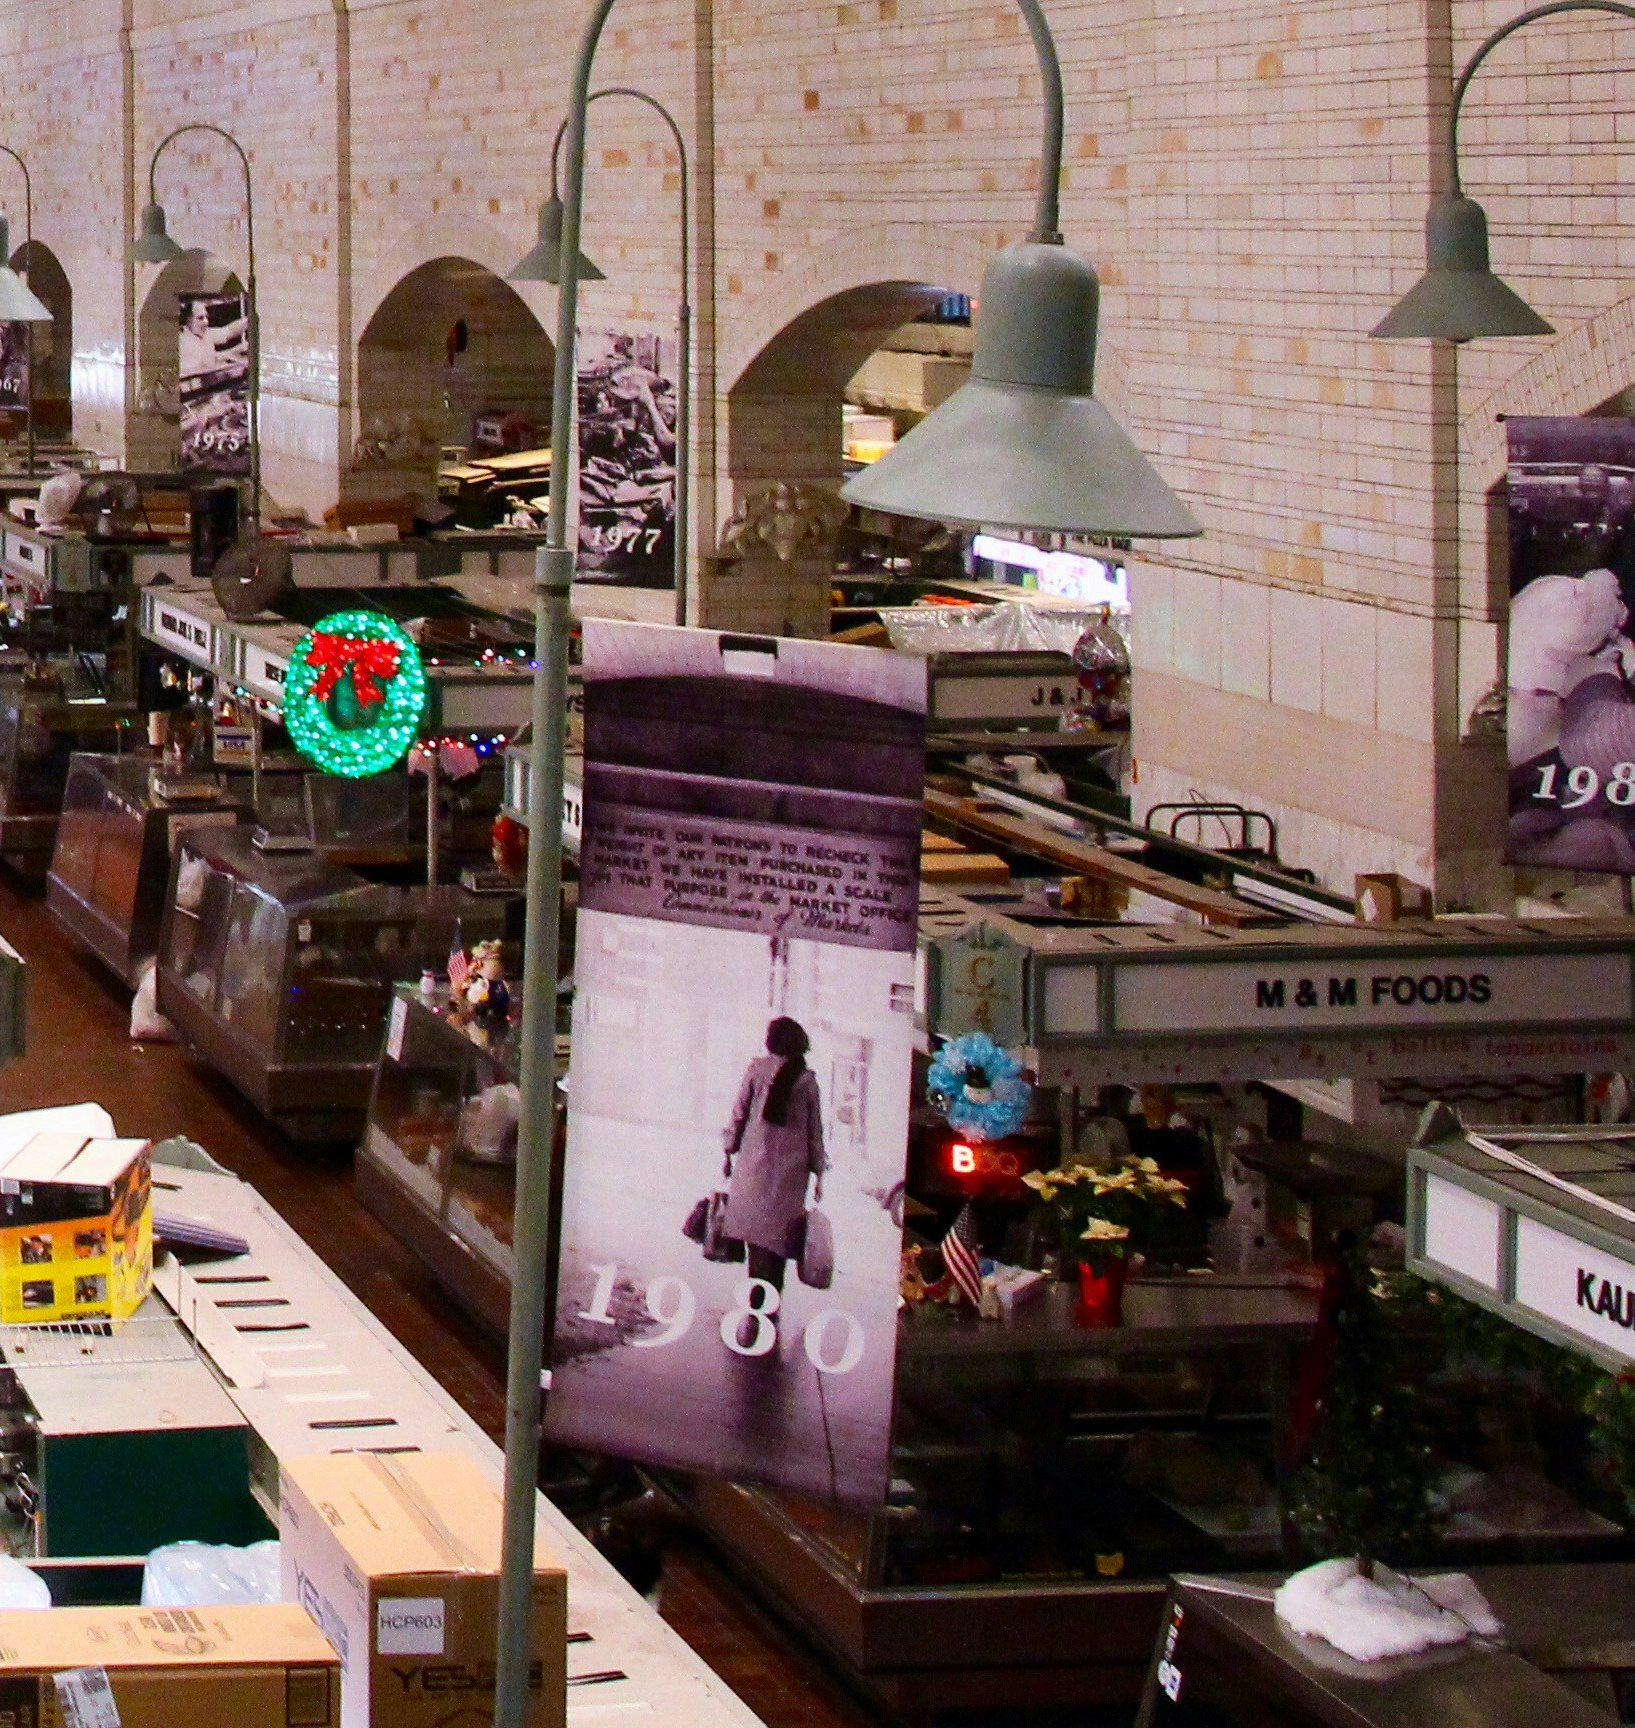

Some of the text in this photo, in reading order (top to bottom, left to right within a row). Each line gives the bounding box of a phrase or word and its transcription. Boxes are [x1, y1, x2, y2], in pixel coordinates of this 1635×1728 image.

[591, 525, 662, 556] 1977
[1531, 761, 1635, 810] 198
[675, 830, 704, 845] OUR
[711, 834, 771, 853] PATRONS
[780, 841, 798, 856] TO
[805, 845, 870, 866] RECHECK
[760, 857, 843, 880] PURCHASED
[738, 871, 818, 894] INSTALLED
[844, 884, 893, 904] SCALE
[789, 894, 851, 915] MARKET
[1256, 974, 1493, 1010] M & M FOODS
[1576, 1266, 1635, 1332] KAU
[577, 1260, 866, 1375] 1980
[379, 1614, 443, 1631] HCP603
